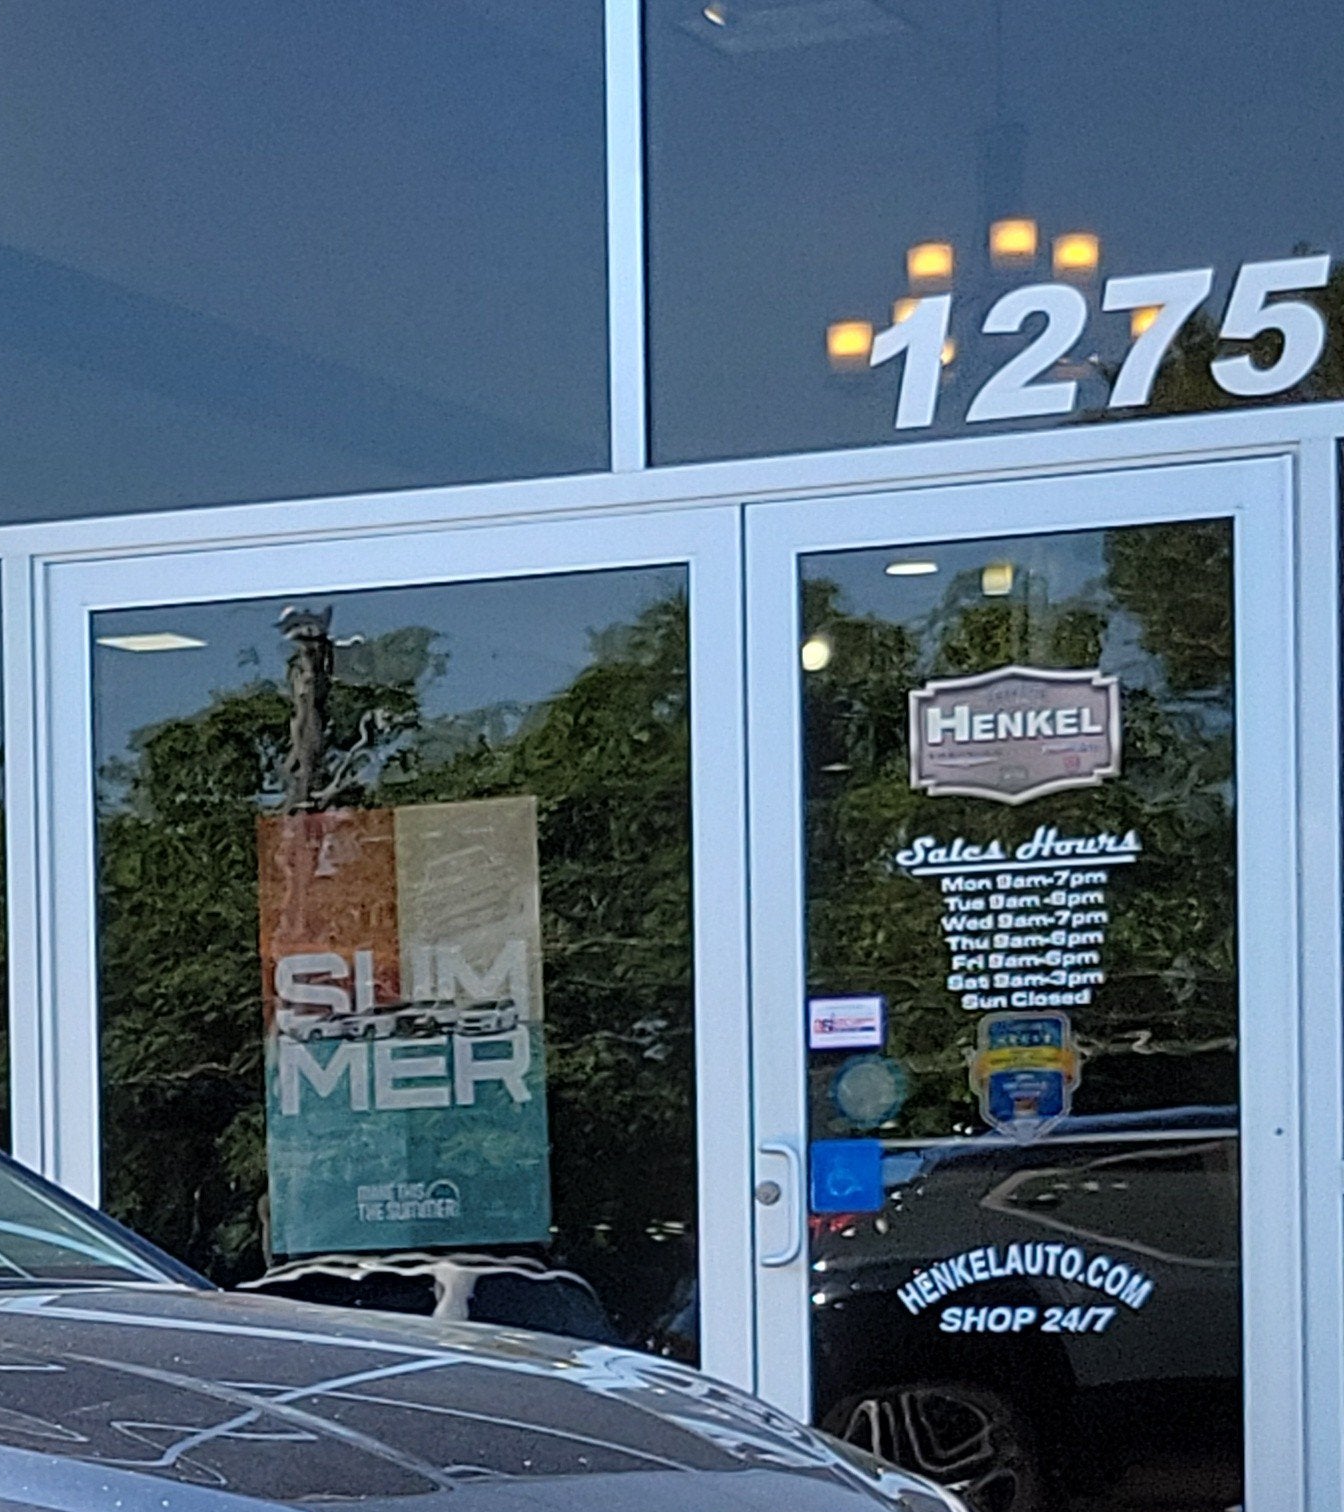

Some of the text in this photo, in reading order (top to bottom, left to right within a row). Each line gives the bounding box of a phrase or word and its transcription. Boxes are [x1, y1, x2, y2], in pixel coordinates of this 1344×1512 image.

[870, 255, 1330, 429] 1275
[927, 705, 1103, 744] HENKEL
[895, 825, 1142, 866] Sales Hours
[941, 876, 992, 893] Mon
[944, 896, 985, 912] Tue
[941, 916, 993, 932] Wed
[944, 936, 990, 952] Thu
[951, 956, 985, 971] Fri
[946, 975, 990, 991] Sat
[961, 988, 1093, 1010] Sun Closed
[275, 1025, 532, 1116] MER
[896, 1243, 1155, 1316] HENKELAUTO.COM
[939, 1306, 1116, 1334] SHOP 24/7
